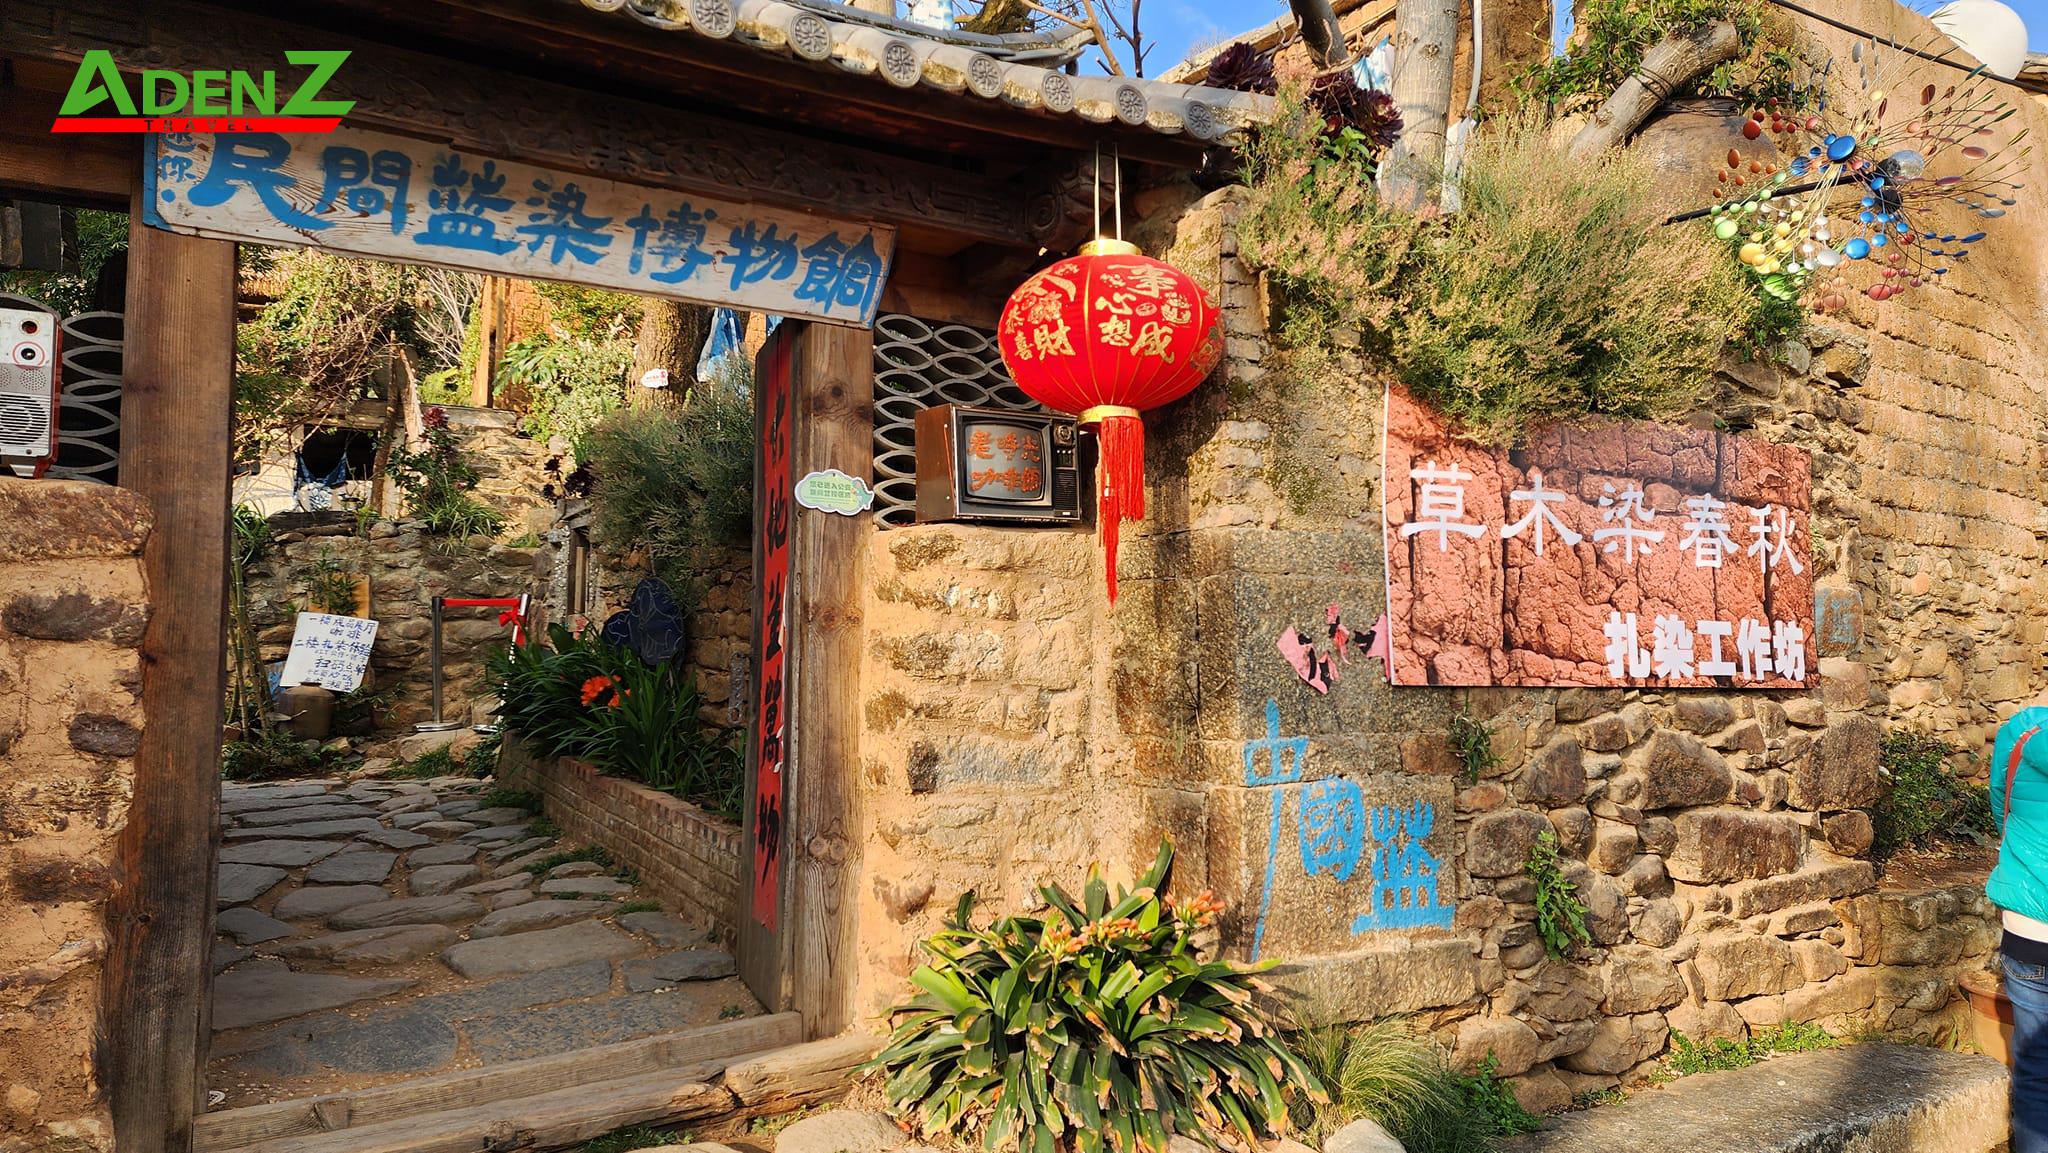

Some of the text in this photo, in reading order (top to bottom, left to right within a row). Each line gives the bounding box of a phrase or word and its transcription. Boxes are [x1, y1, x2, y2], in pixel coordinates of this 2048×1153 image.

[187, 130, 884, 322] 民間藍染博物館
[1402, 460, 1805, 576] 草木染春秋
[1605, 610, 1806, 682] 扎染工作坊
